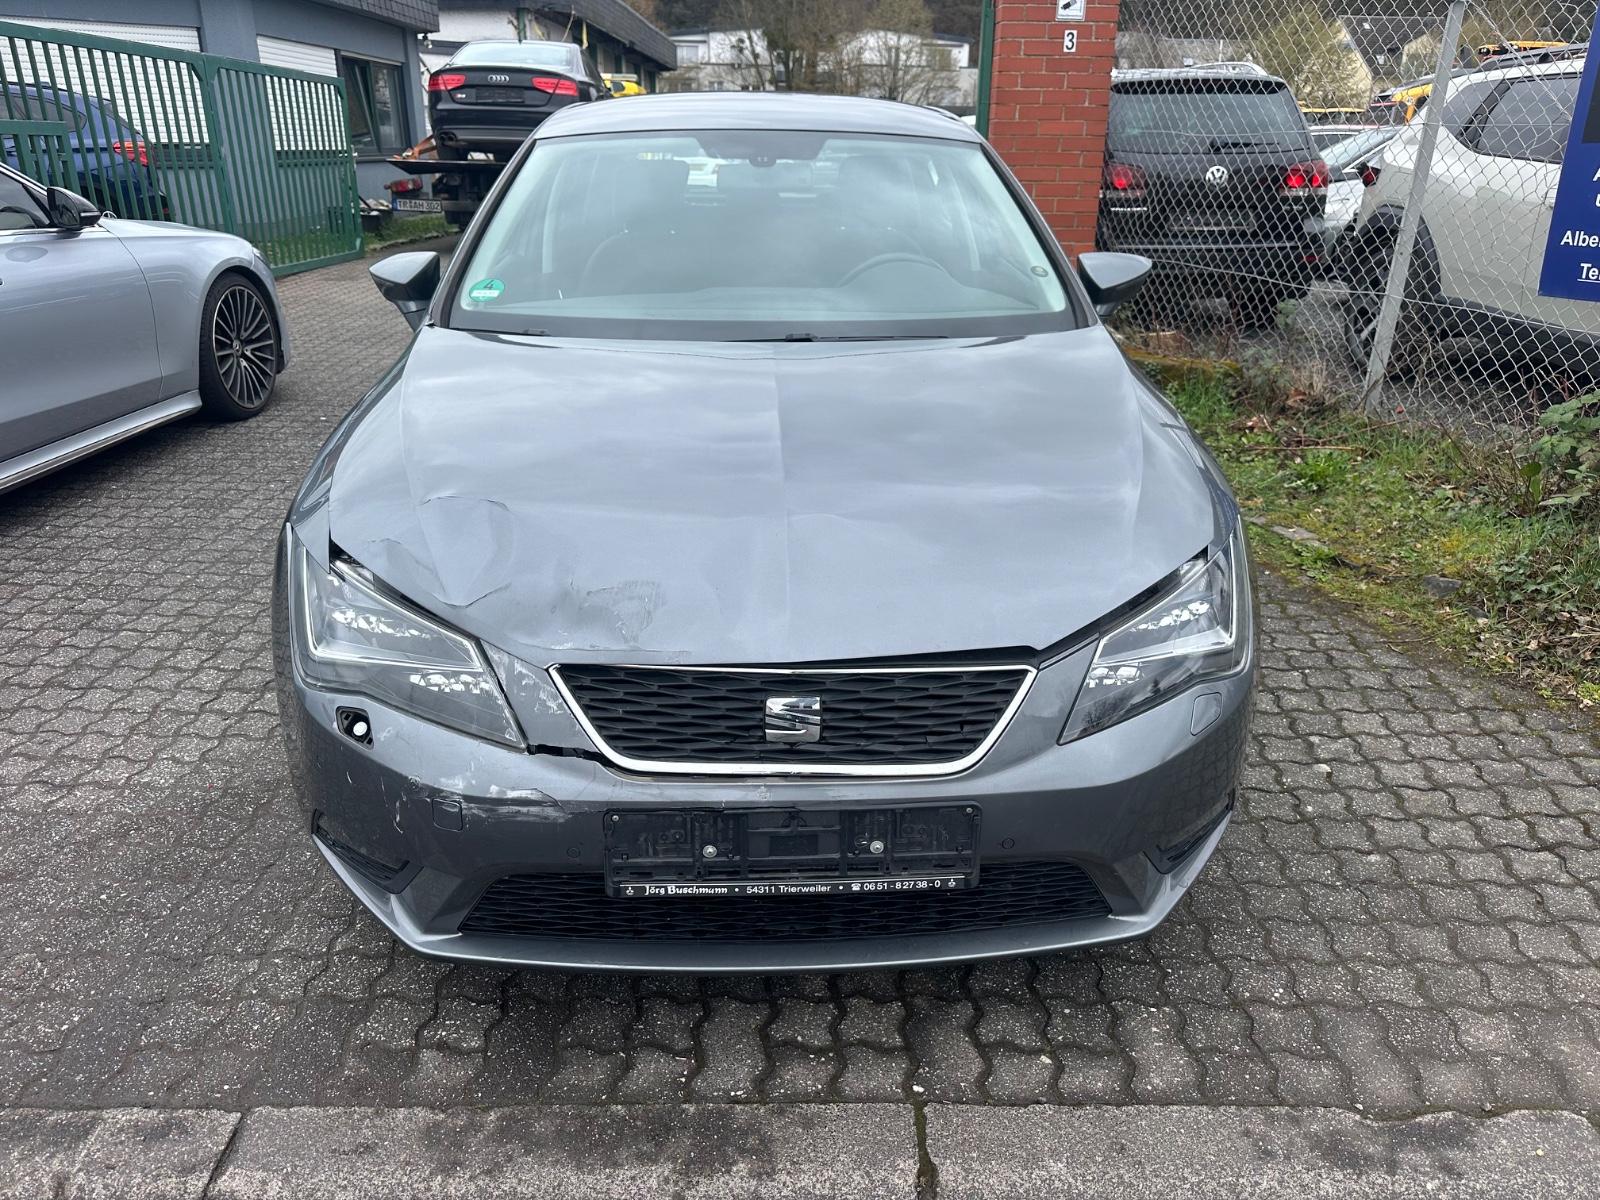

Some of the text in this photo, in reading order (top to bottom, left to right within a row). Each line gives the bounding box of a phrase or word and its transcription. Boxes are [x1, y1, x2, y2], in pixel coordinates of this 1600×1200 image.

[1065, 31, 1075, 51] 3
[1560, 230, 1600, 248] Albe
[1580, 262, 1600, 281] Te
[483, 279, 495, 291] 4
[644, 885, 665, 896] Jörg
[667, 885, 728, 895] Buschmann
[746, 885, 775, 894] 54311
[778, 884, 831, 894] Trierweiler
